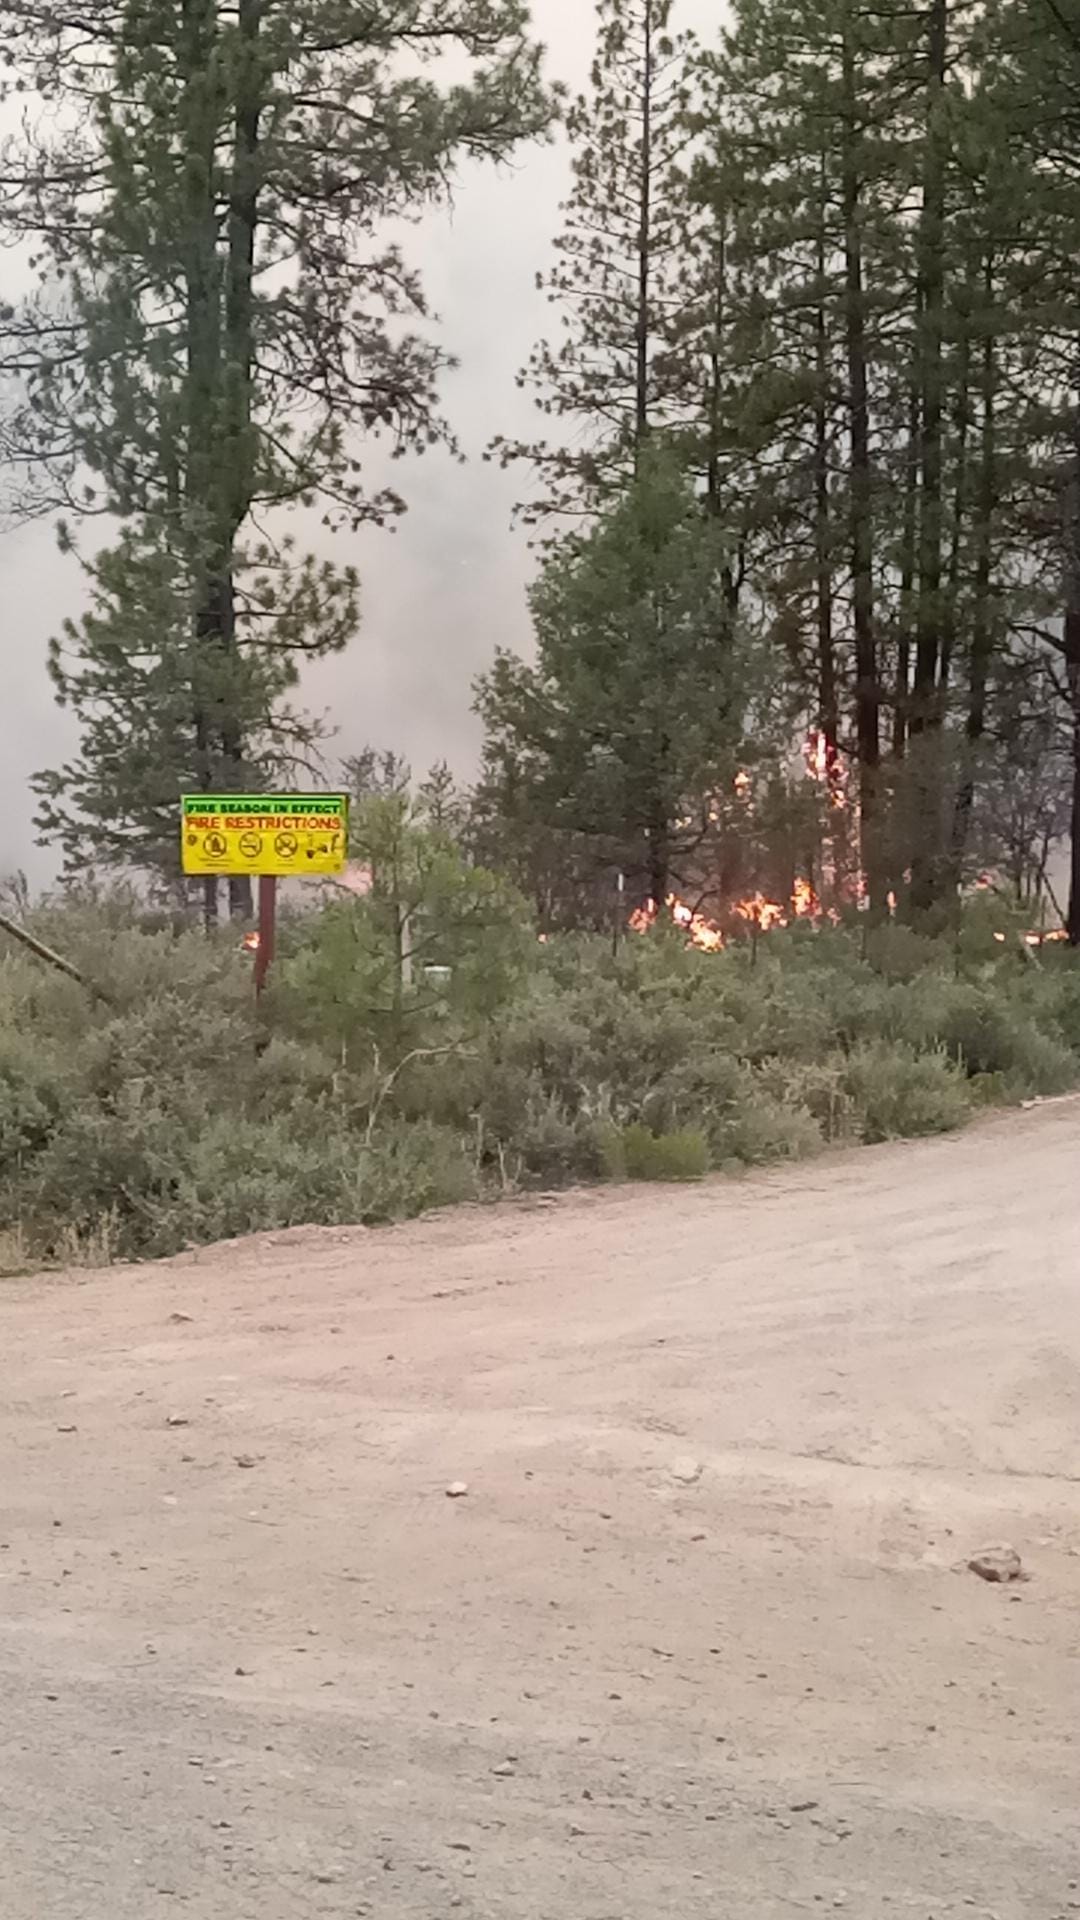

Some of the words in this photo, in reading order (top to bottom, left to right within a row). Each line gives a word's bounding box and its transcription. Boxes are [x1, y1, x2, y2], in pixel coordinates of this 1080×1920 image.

[187, 804, 216, 814] FIRE
[220, 804, 270, 814] SEASON
[274, 804, 288, 814] IN
[291, 804, 340, 814] EFFECT
[186, 817, 220, 829] FIRE
[225, 817, 341, 829] RESTRICTIONS
